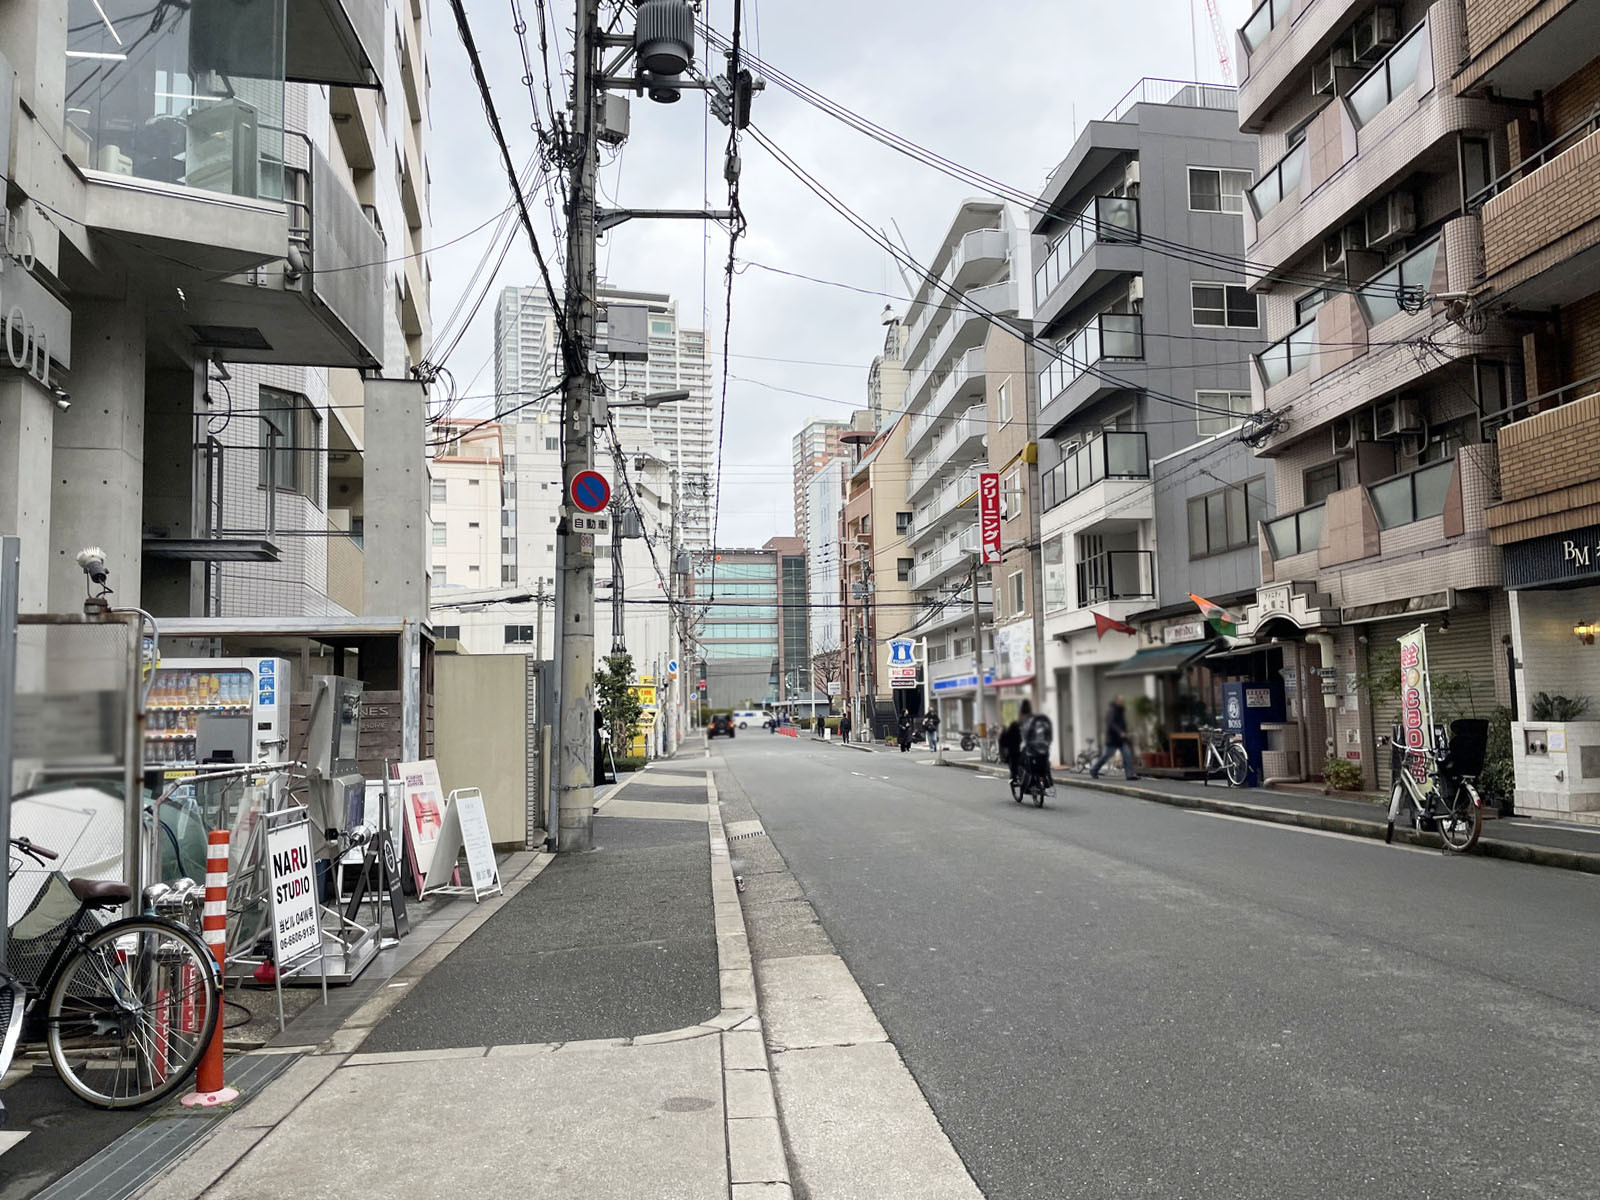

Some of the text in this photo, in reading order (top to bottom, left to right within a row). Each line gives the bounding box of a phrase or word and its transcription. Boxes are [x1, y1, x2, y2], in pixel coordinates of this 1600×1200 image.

[982, 477, 999, 541] クリーニング
[574, 518, 608, 530] 自動車
[1563, 541, 1591, 567] BM
[1228, 719, 1241, 728] BOSS
[272, 845, 308, 879] NARU
[276, 875, 310, 904] STUDIO
